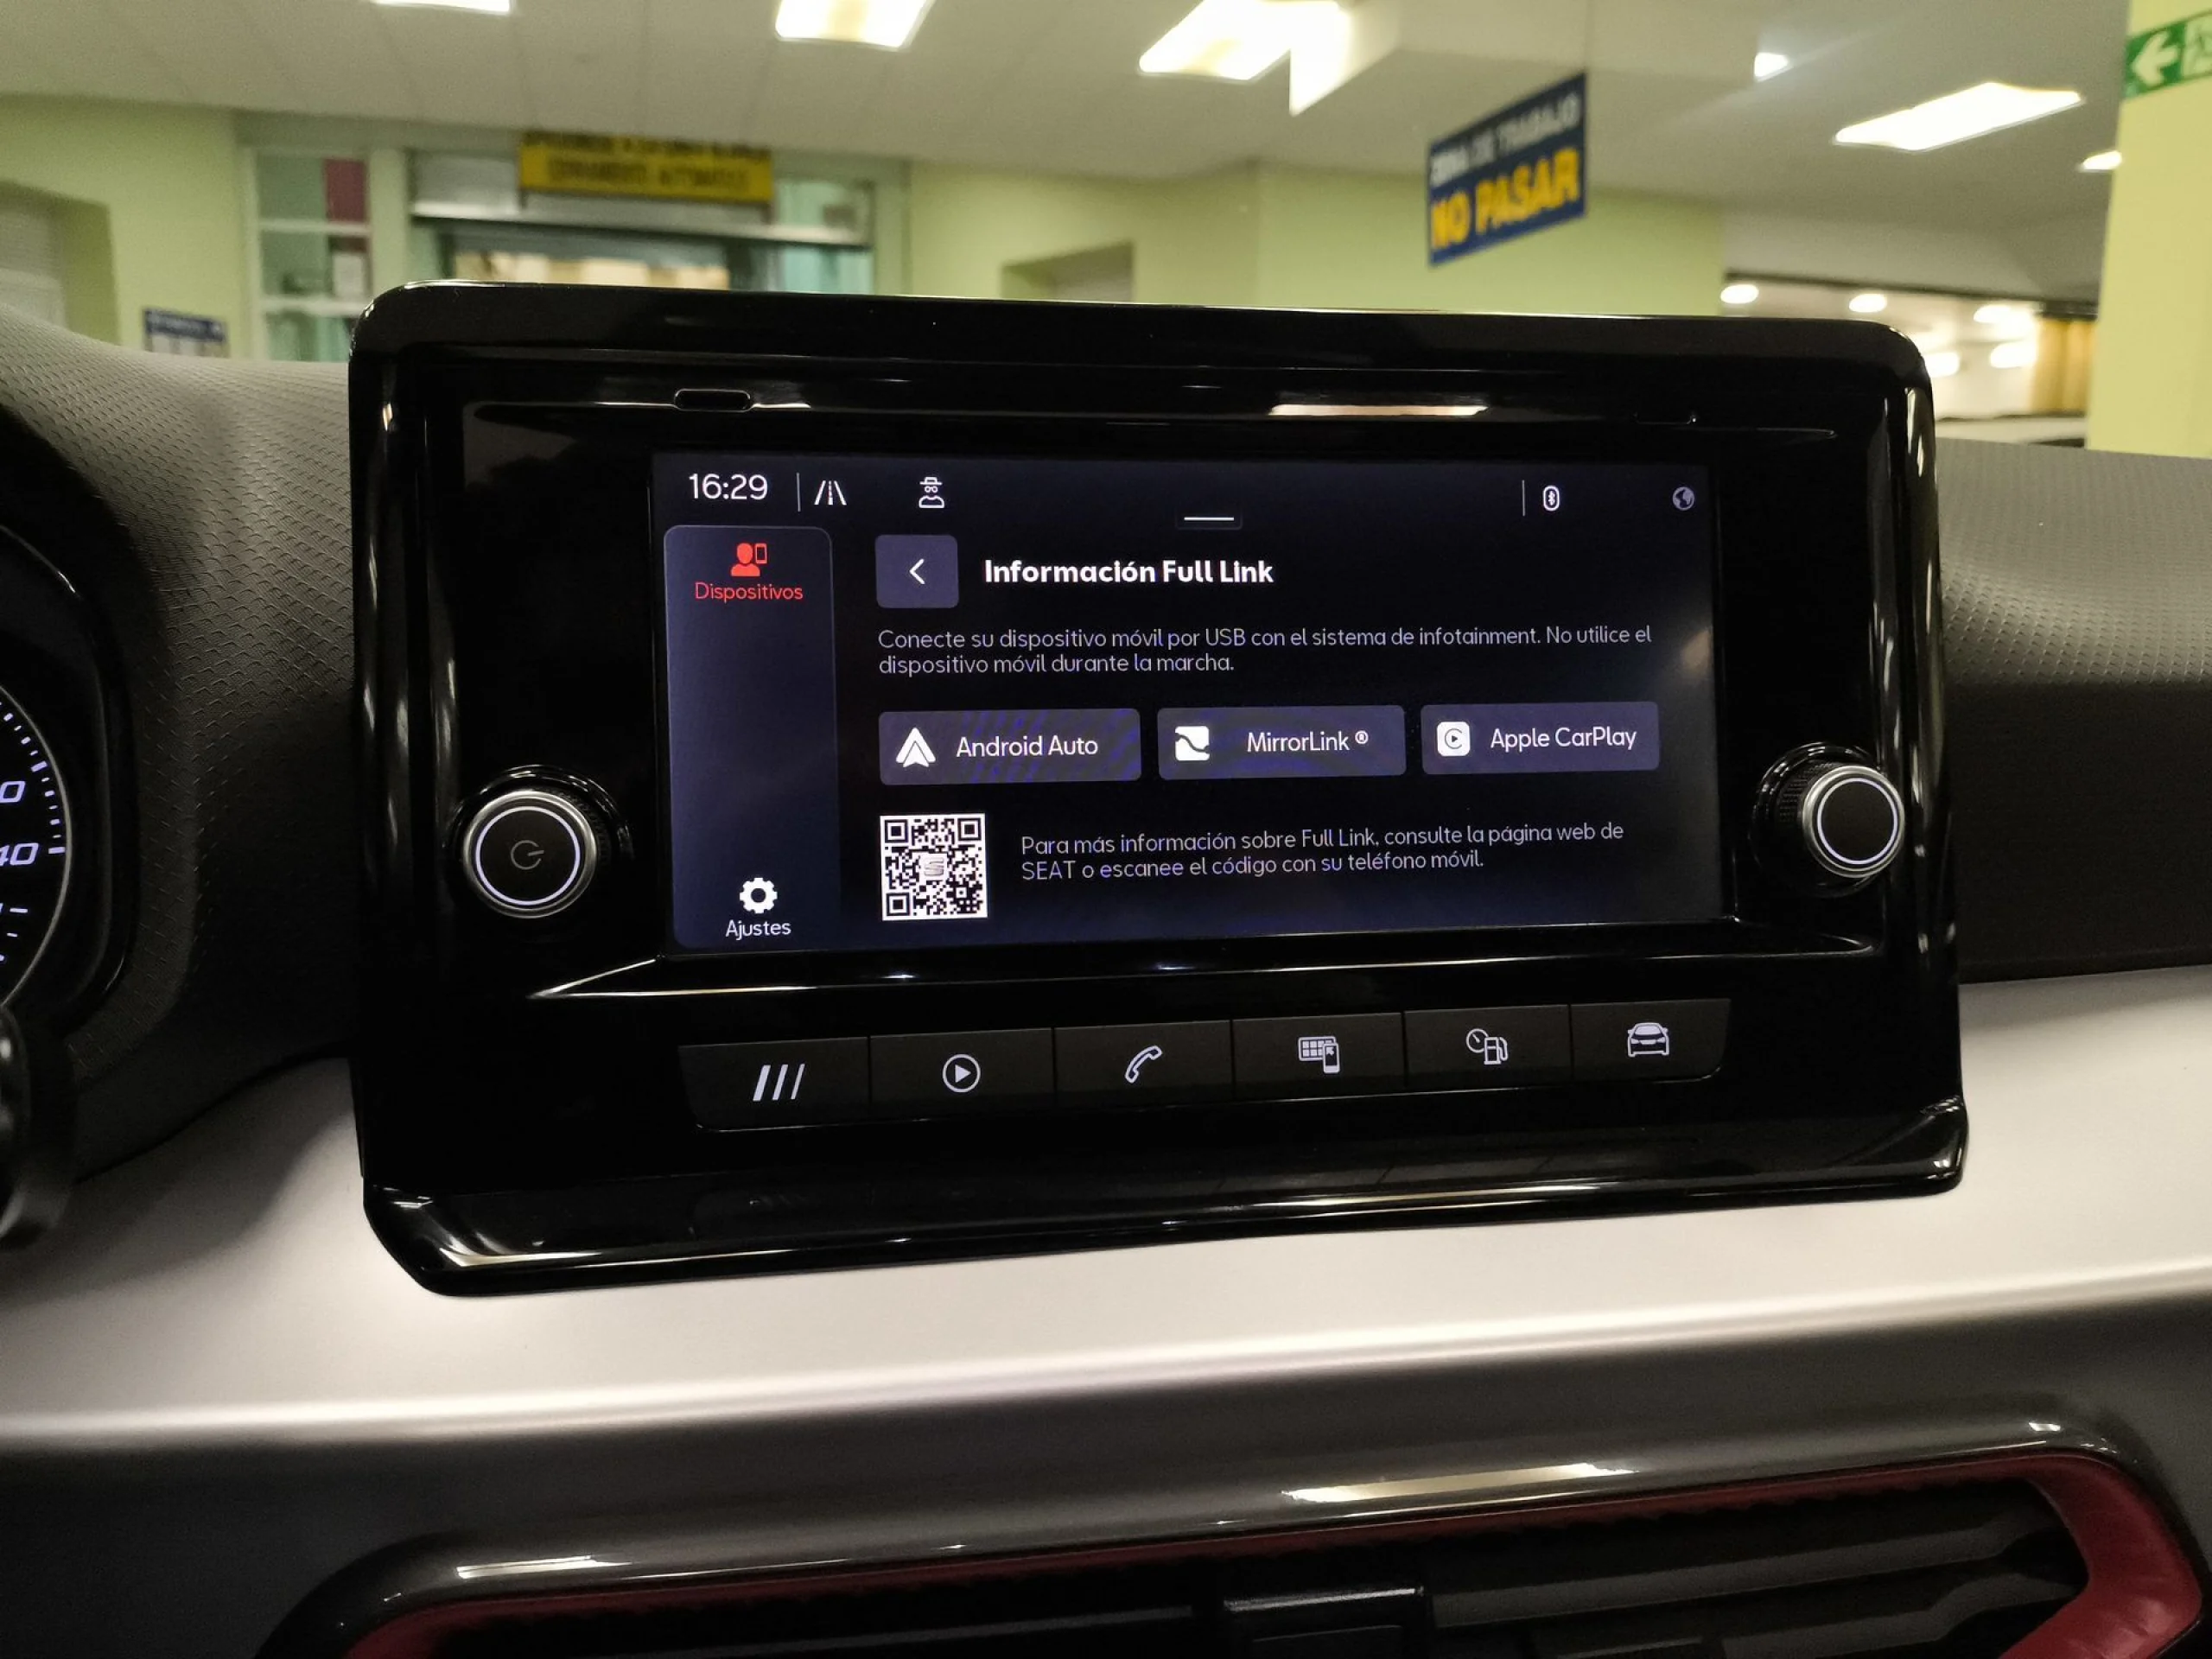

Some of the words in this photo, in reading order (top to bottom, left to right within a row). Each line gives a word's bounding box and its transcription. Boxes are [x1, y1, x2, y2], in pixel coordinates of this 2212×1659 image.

[1431, 189, 1471, 250] NO
[1475, 147, 1580, 235] PASAR
[689, 473, 768, 500] 16:29
[985, 559, 1157, 583] Información
[1162, 559, 1214, 583] Full
[1219, 560, 1274, 583] Link
[695, 582, 804, 603] Dispositivos
[878, 629, 966, 649] Conecte
[970, 633, 994, 648] su
[999, 628, 1107, 652] dispositivo
[1112, 628, 1164, 647] móvil
[1167, 632, 1200, 651] por
[1205, 627, 1246, 646] USB
[1250, 632, 1286, 646] con
[1290, 627, 1308, 646] el
[1312, 627, 1387, 646] sistema
[1390, 627, 1414, 645] de
[1420, 626, 1541, 645] infotainment.
[1546, 626, 1573, 644] No
[1576, 625, 1630, 644] utilice
[1635, 625, 1652, 643] el
[879, 654, 988, 678] dispositivo
[994, 653, 1047, 673] móvil
[1051, 653, 1129, 672] durante
[1134, 652, 1152, 671] la
[1156, 652, 1235, 671] marcha.
[956, 735, 1044, 758] Android
[1047, 734, 1099, 756] Auto
[1247, 730, 1351, 753] MirrorLink
[1490, 728, 1550, 753] Apple
[1554, 726, 1637, 751] CarPlay
[1021, 836, 1069, 855] Para
[1074, 836, 1116, 855] más
[1121, 832, 1236, 853] información
[1241, 830, 1297, 849] sobre
[1301, 829, 1334, 848] Full
[1384, 825, 1463, 845] consulte
[1466, 825, 1484, 843] la
[1488, 823, 1553, 847] página
[1556, 822, 1596, 841] web
[1600, 821, 1624, 840] de
[1021, 860, 1077, 880] SEAT
[1082, 864, 1095, 879] o
[1099, 862, 1185, 879] escanee
[1189, 856, 1208, 875] el
[1211, 855, 1277, 878] código
[1281, 858, 1316, 873] con
[1320, 857, 1343, 872] su
[1347, 851, 1427, 871] teléfono
[1430, 849, 1484, 868] móvil.
[725, 919, 791, 941] Ajustes
